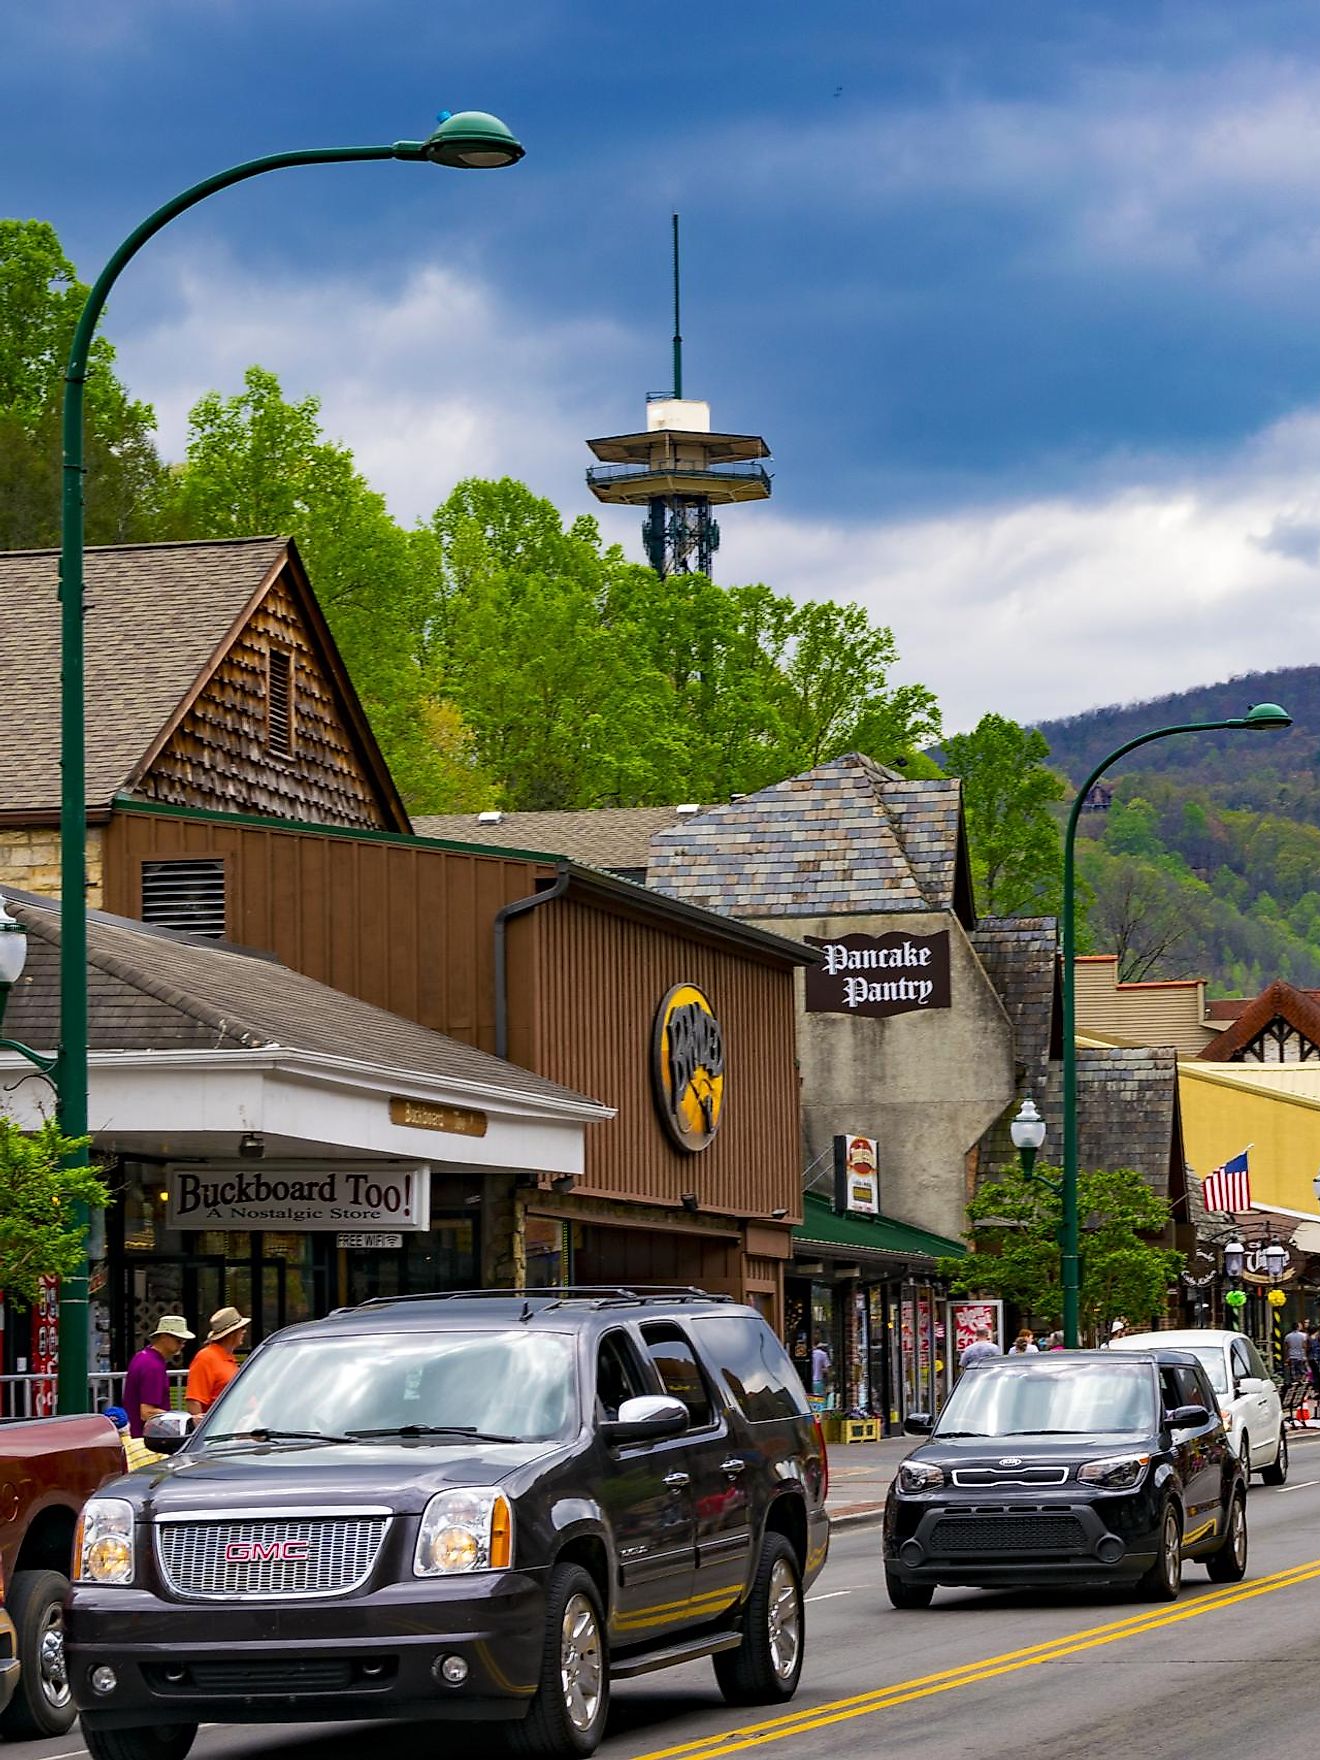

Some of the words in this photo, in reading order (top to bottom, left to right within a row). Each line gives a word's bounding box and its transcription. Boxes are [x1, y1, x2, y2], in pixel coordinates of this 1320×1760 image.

[822, 941, 932, 975] Pancake
[842, 976, 933, 1008] Pantry
[177, 1172, 338, 1215] Buckboard
[346, 1174, 411, 1217] Too!
[206, 1207, 222, 1219] A
[231, 1207, 323, 1222] Nostalgic
[330, 1207, 381, 1219] Store
[338, 1234, 362, 1247] FREE
[225, 1541, 309, 1561] GMC
